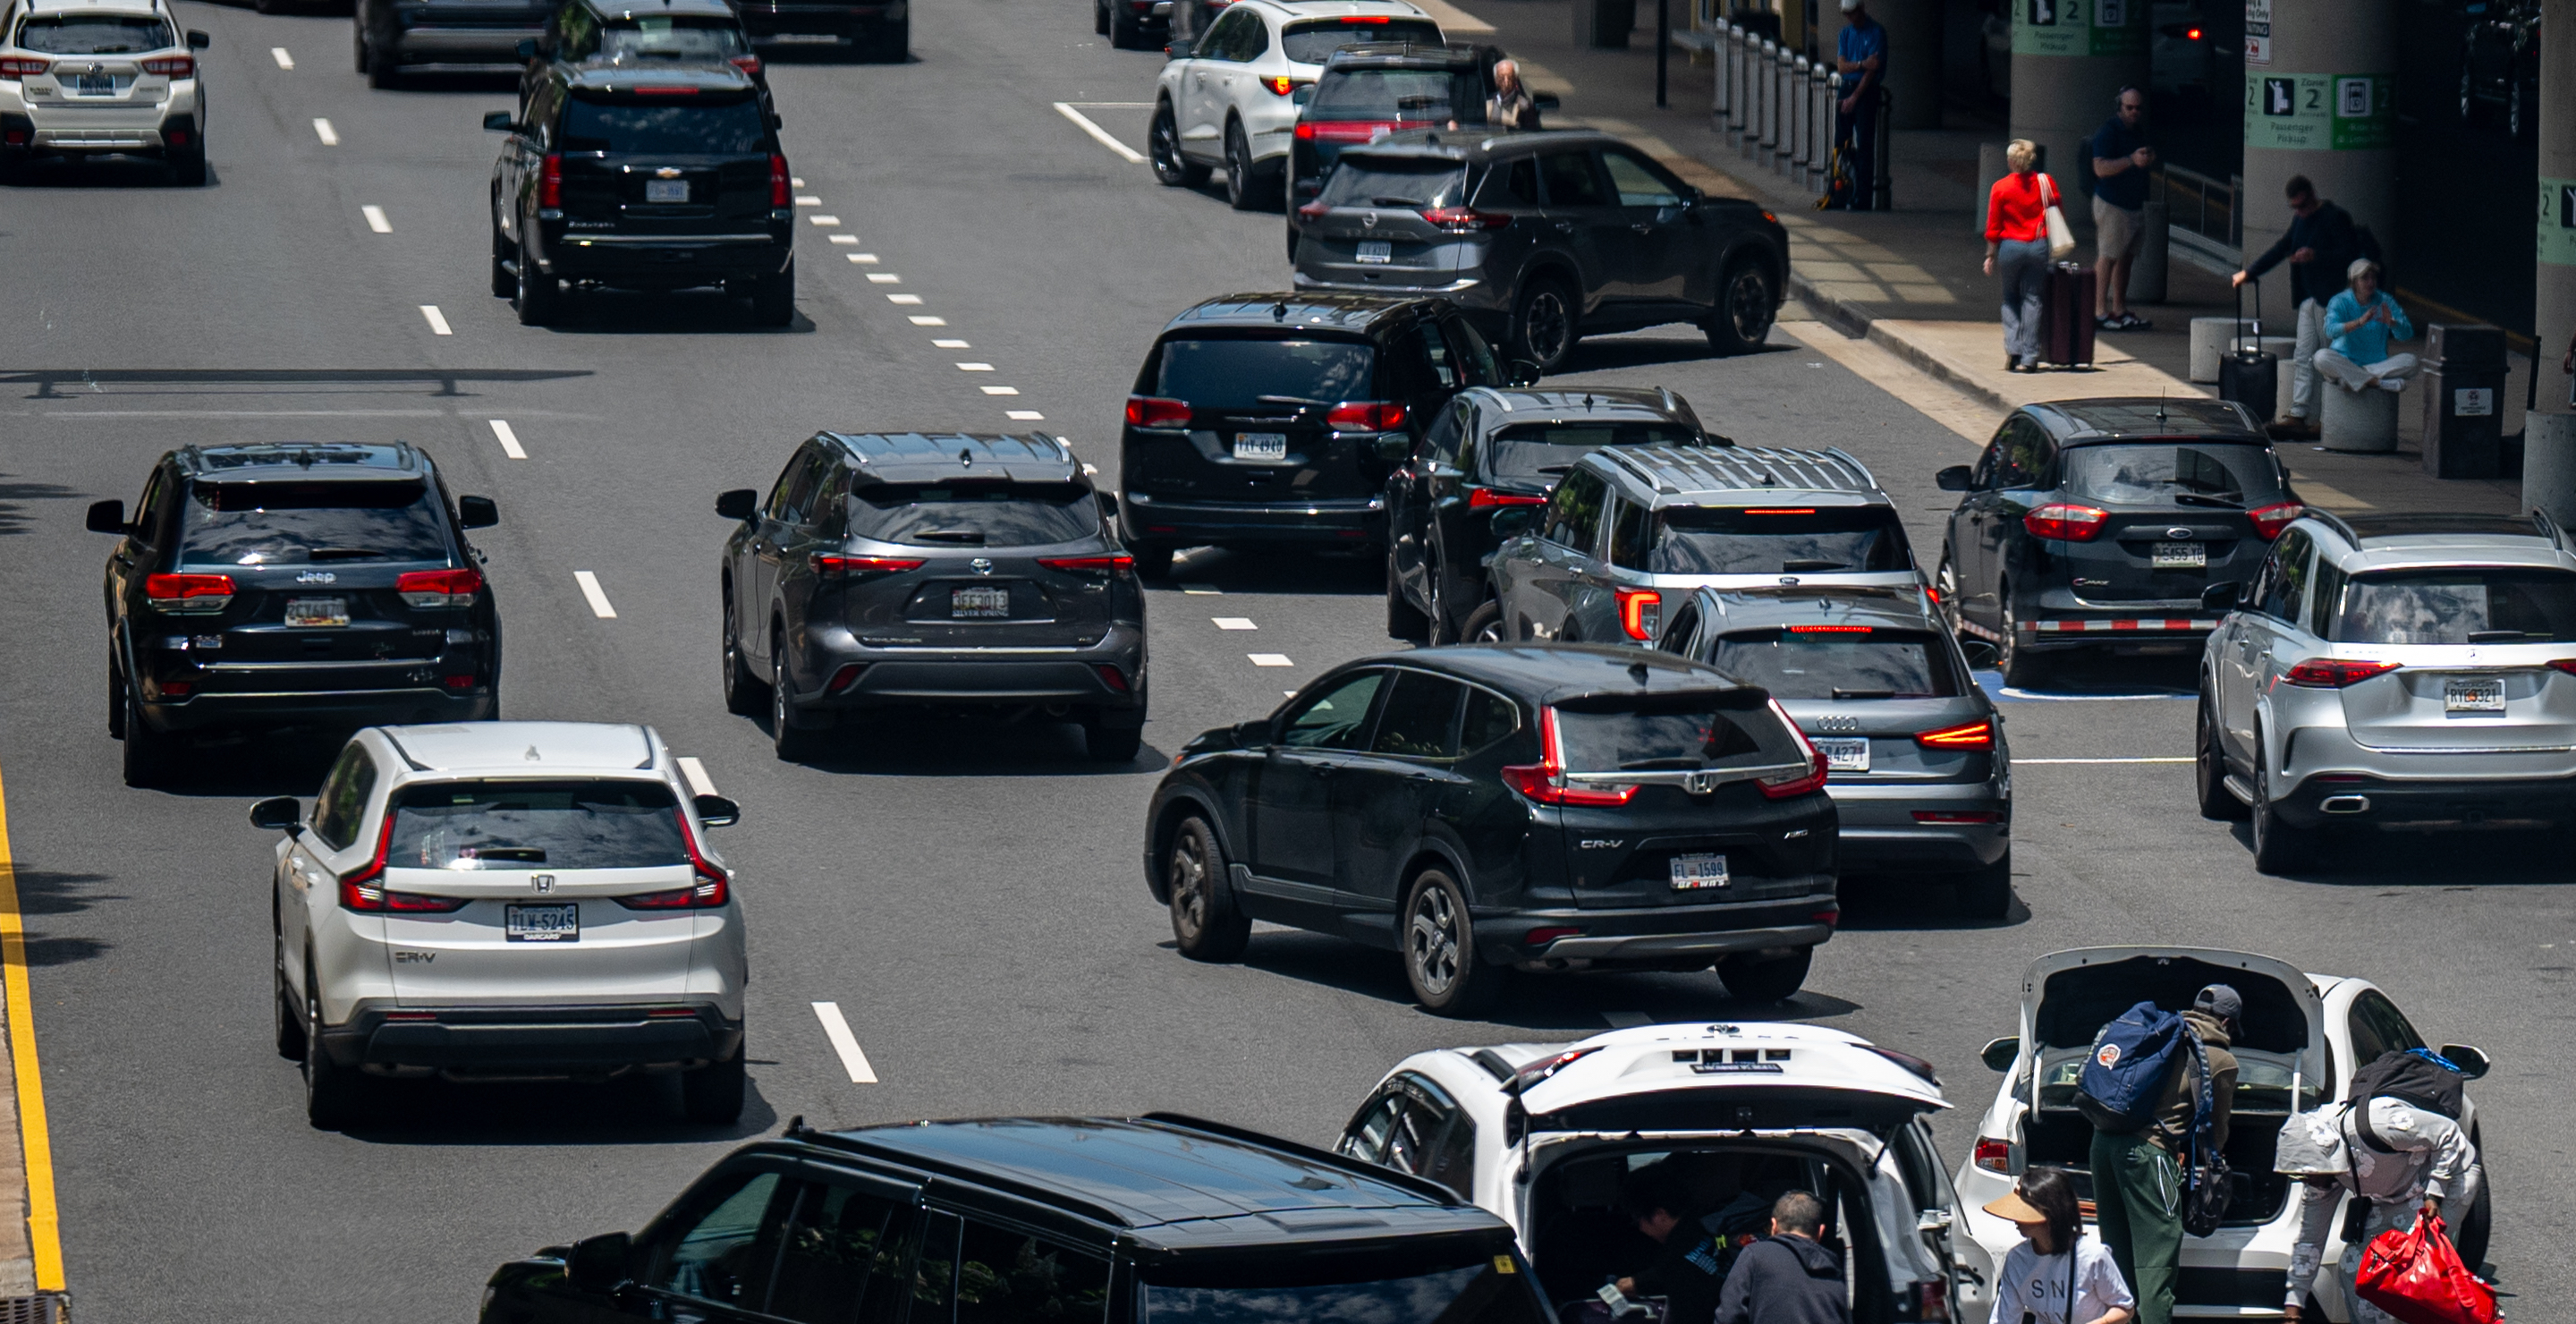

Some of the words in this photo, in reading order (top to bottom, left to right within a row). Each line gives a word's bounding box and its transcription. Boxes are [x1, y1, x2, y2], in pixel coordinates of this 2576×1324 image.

[2065, 0, 2079, 20] 2
[2305, 89, 2320, 109] 2
[2270, 123, 2315, 133] Passenger
[2542, 192, 2550, 216] 2
[296, 570, 336, 585] Jeep
[1580, 839, 1624, 849] CR-V
[1698, 861, 1724, 878] 1599
[394, 951, 436, 963] CR-V
